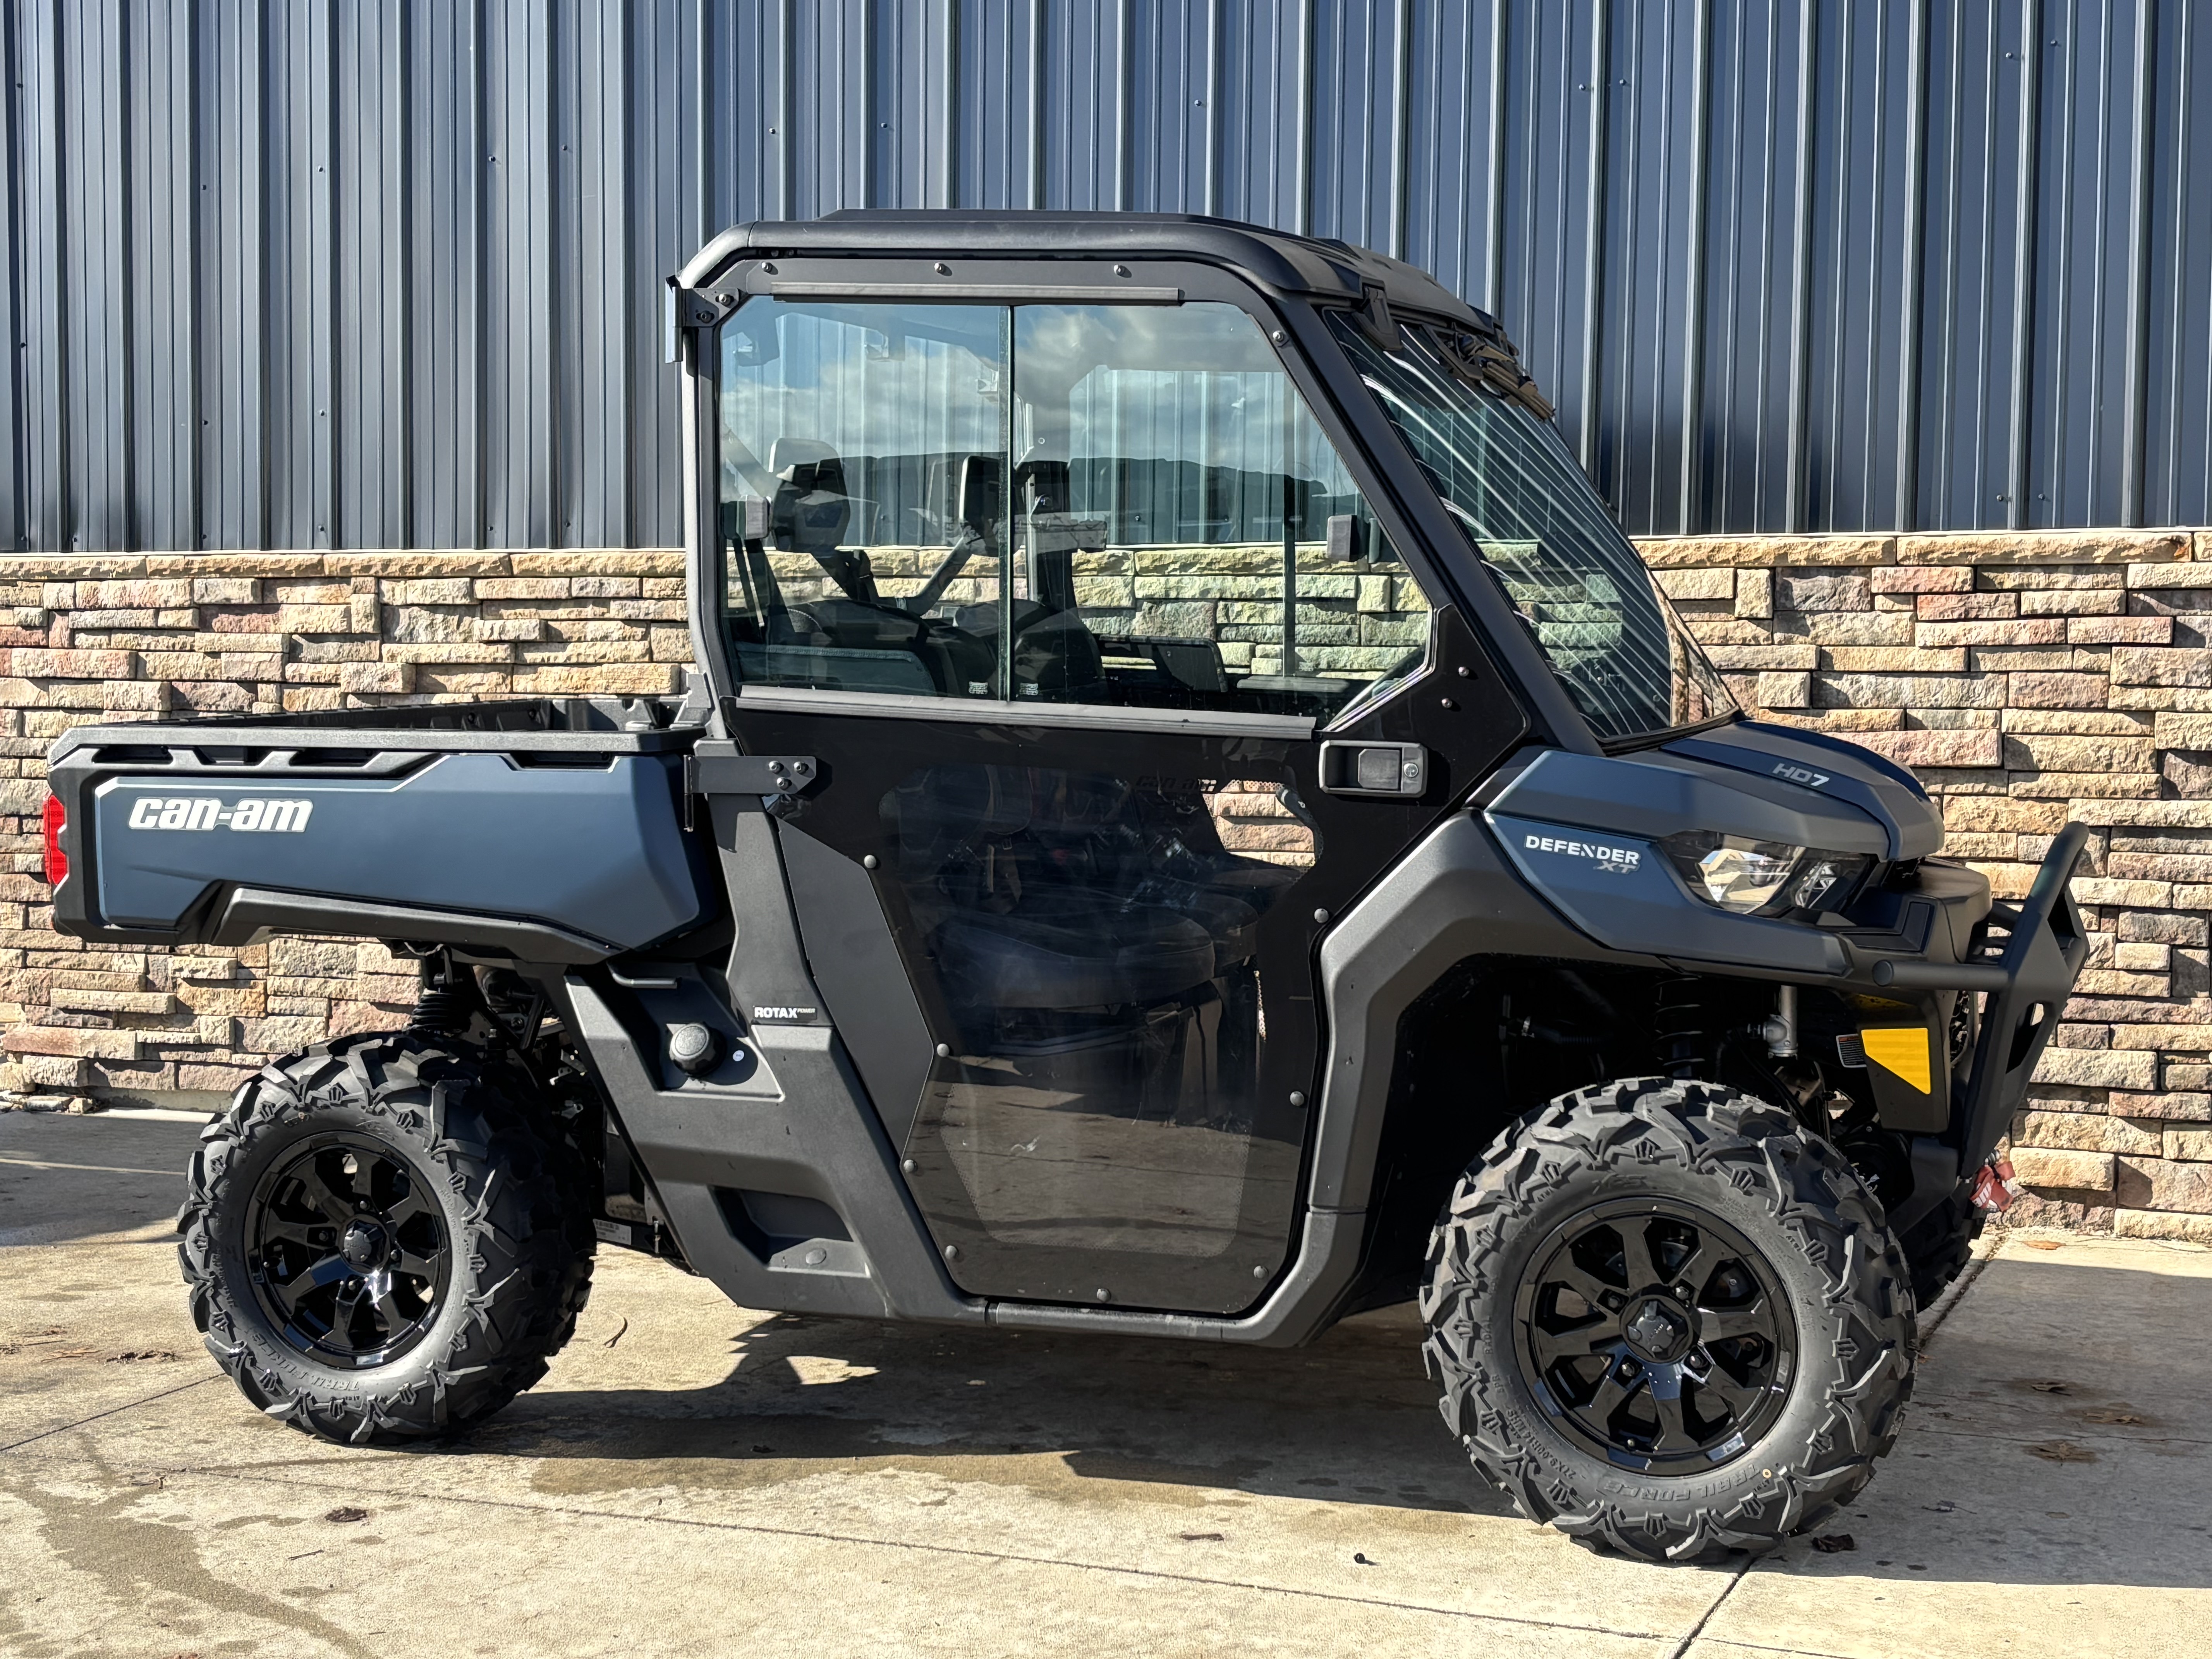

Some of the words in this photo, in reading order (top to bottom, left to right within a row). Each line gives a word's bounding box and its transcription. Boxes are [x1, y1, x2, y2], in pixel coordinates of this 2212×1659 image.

[1772, 763, 1830, 787] HD7
[129, 798, 313, 831] can-am
[1525, 835, 1639, 865] DEFENDER
[1594, 861, 1637, 873] XT
[754, 1007, 798, 1018] ROTAX
[1697, 1463, 1760, 1498] TRAIL
